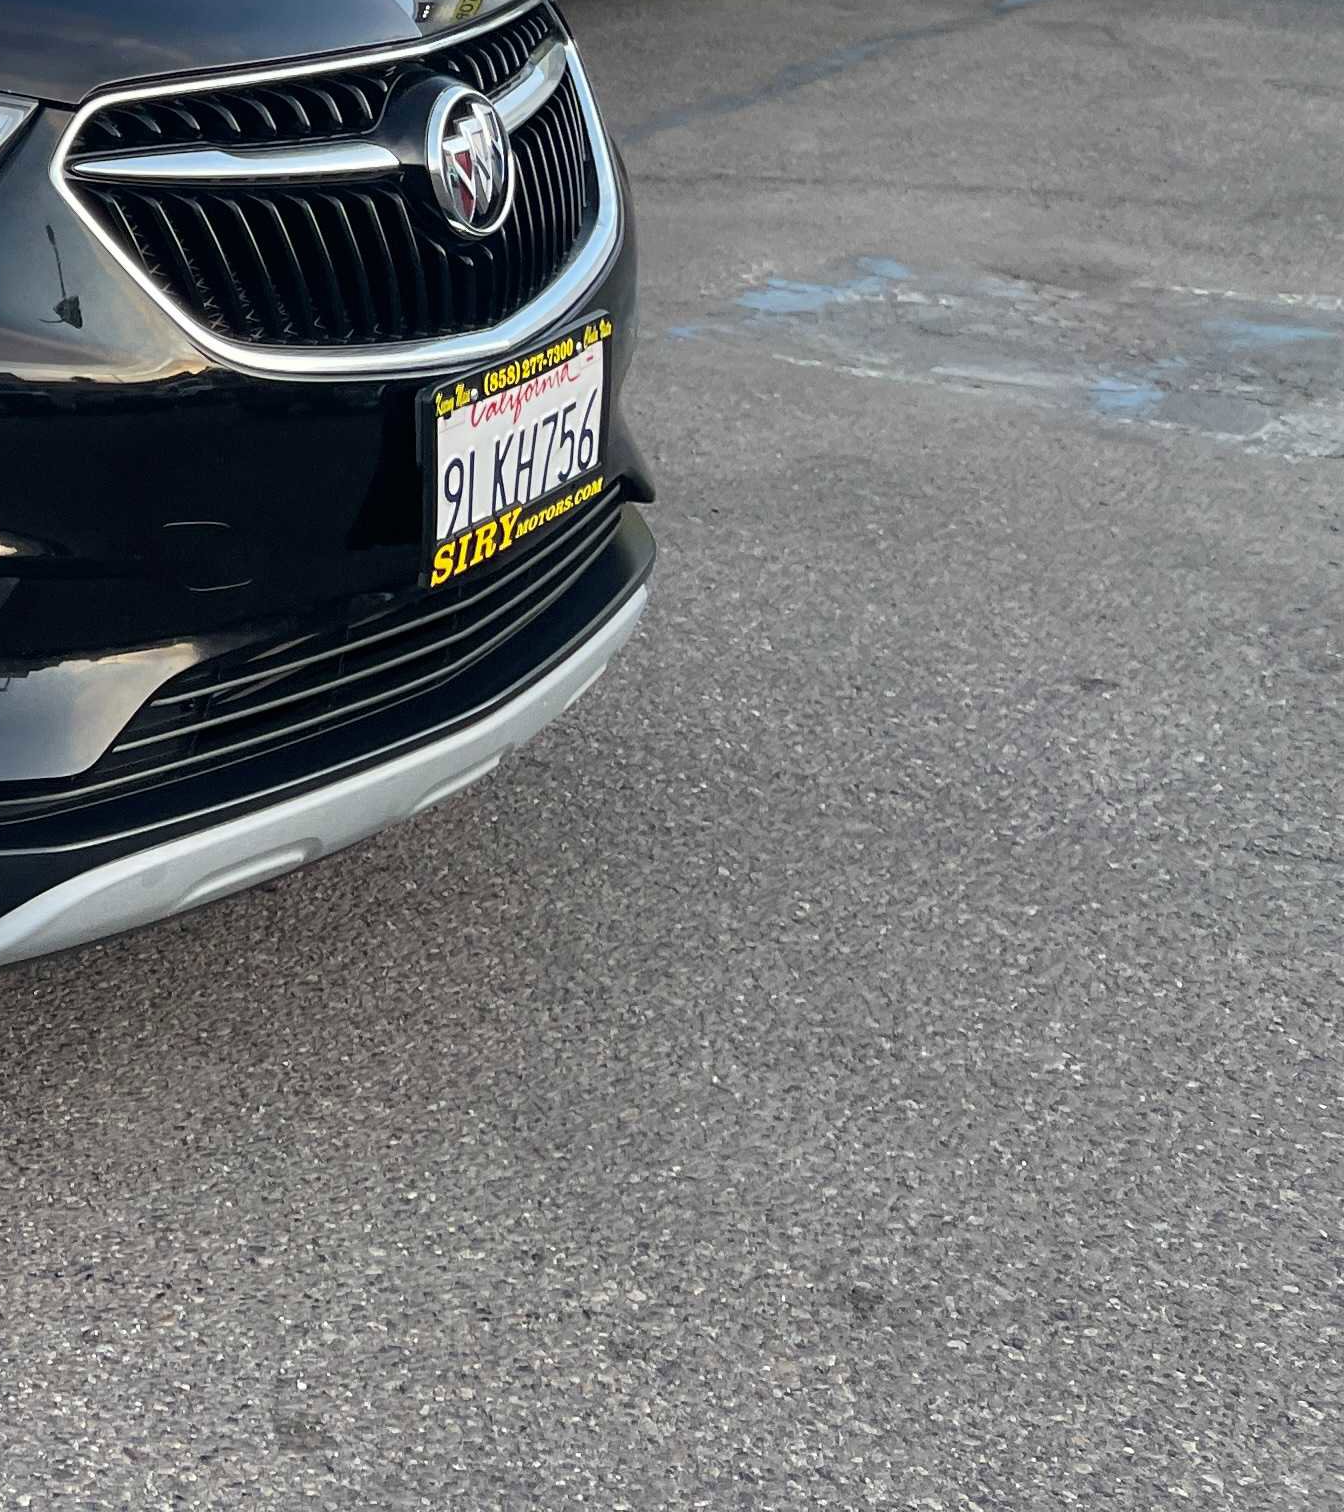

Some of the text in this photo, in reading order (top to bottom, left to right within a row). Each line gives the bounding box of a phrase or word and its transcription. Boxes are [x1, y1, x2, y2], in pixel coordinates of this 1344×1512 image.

[470, 363, 580, 428] California
[483, 361, 521, 396] (858)
[522, 338, 574, 379] 277-7300
[430, 476, 604, 588] SIRY MOTORS.COM
